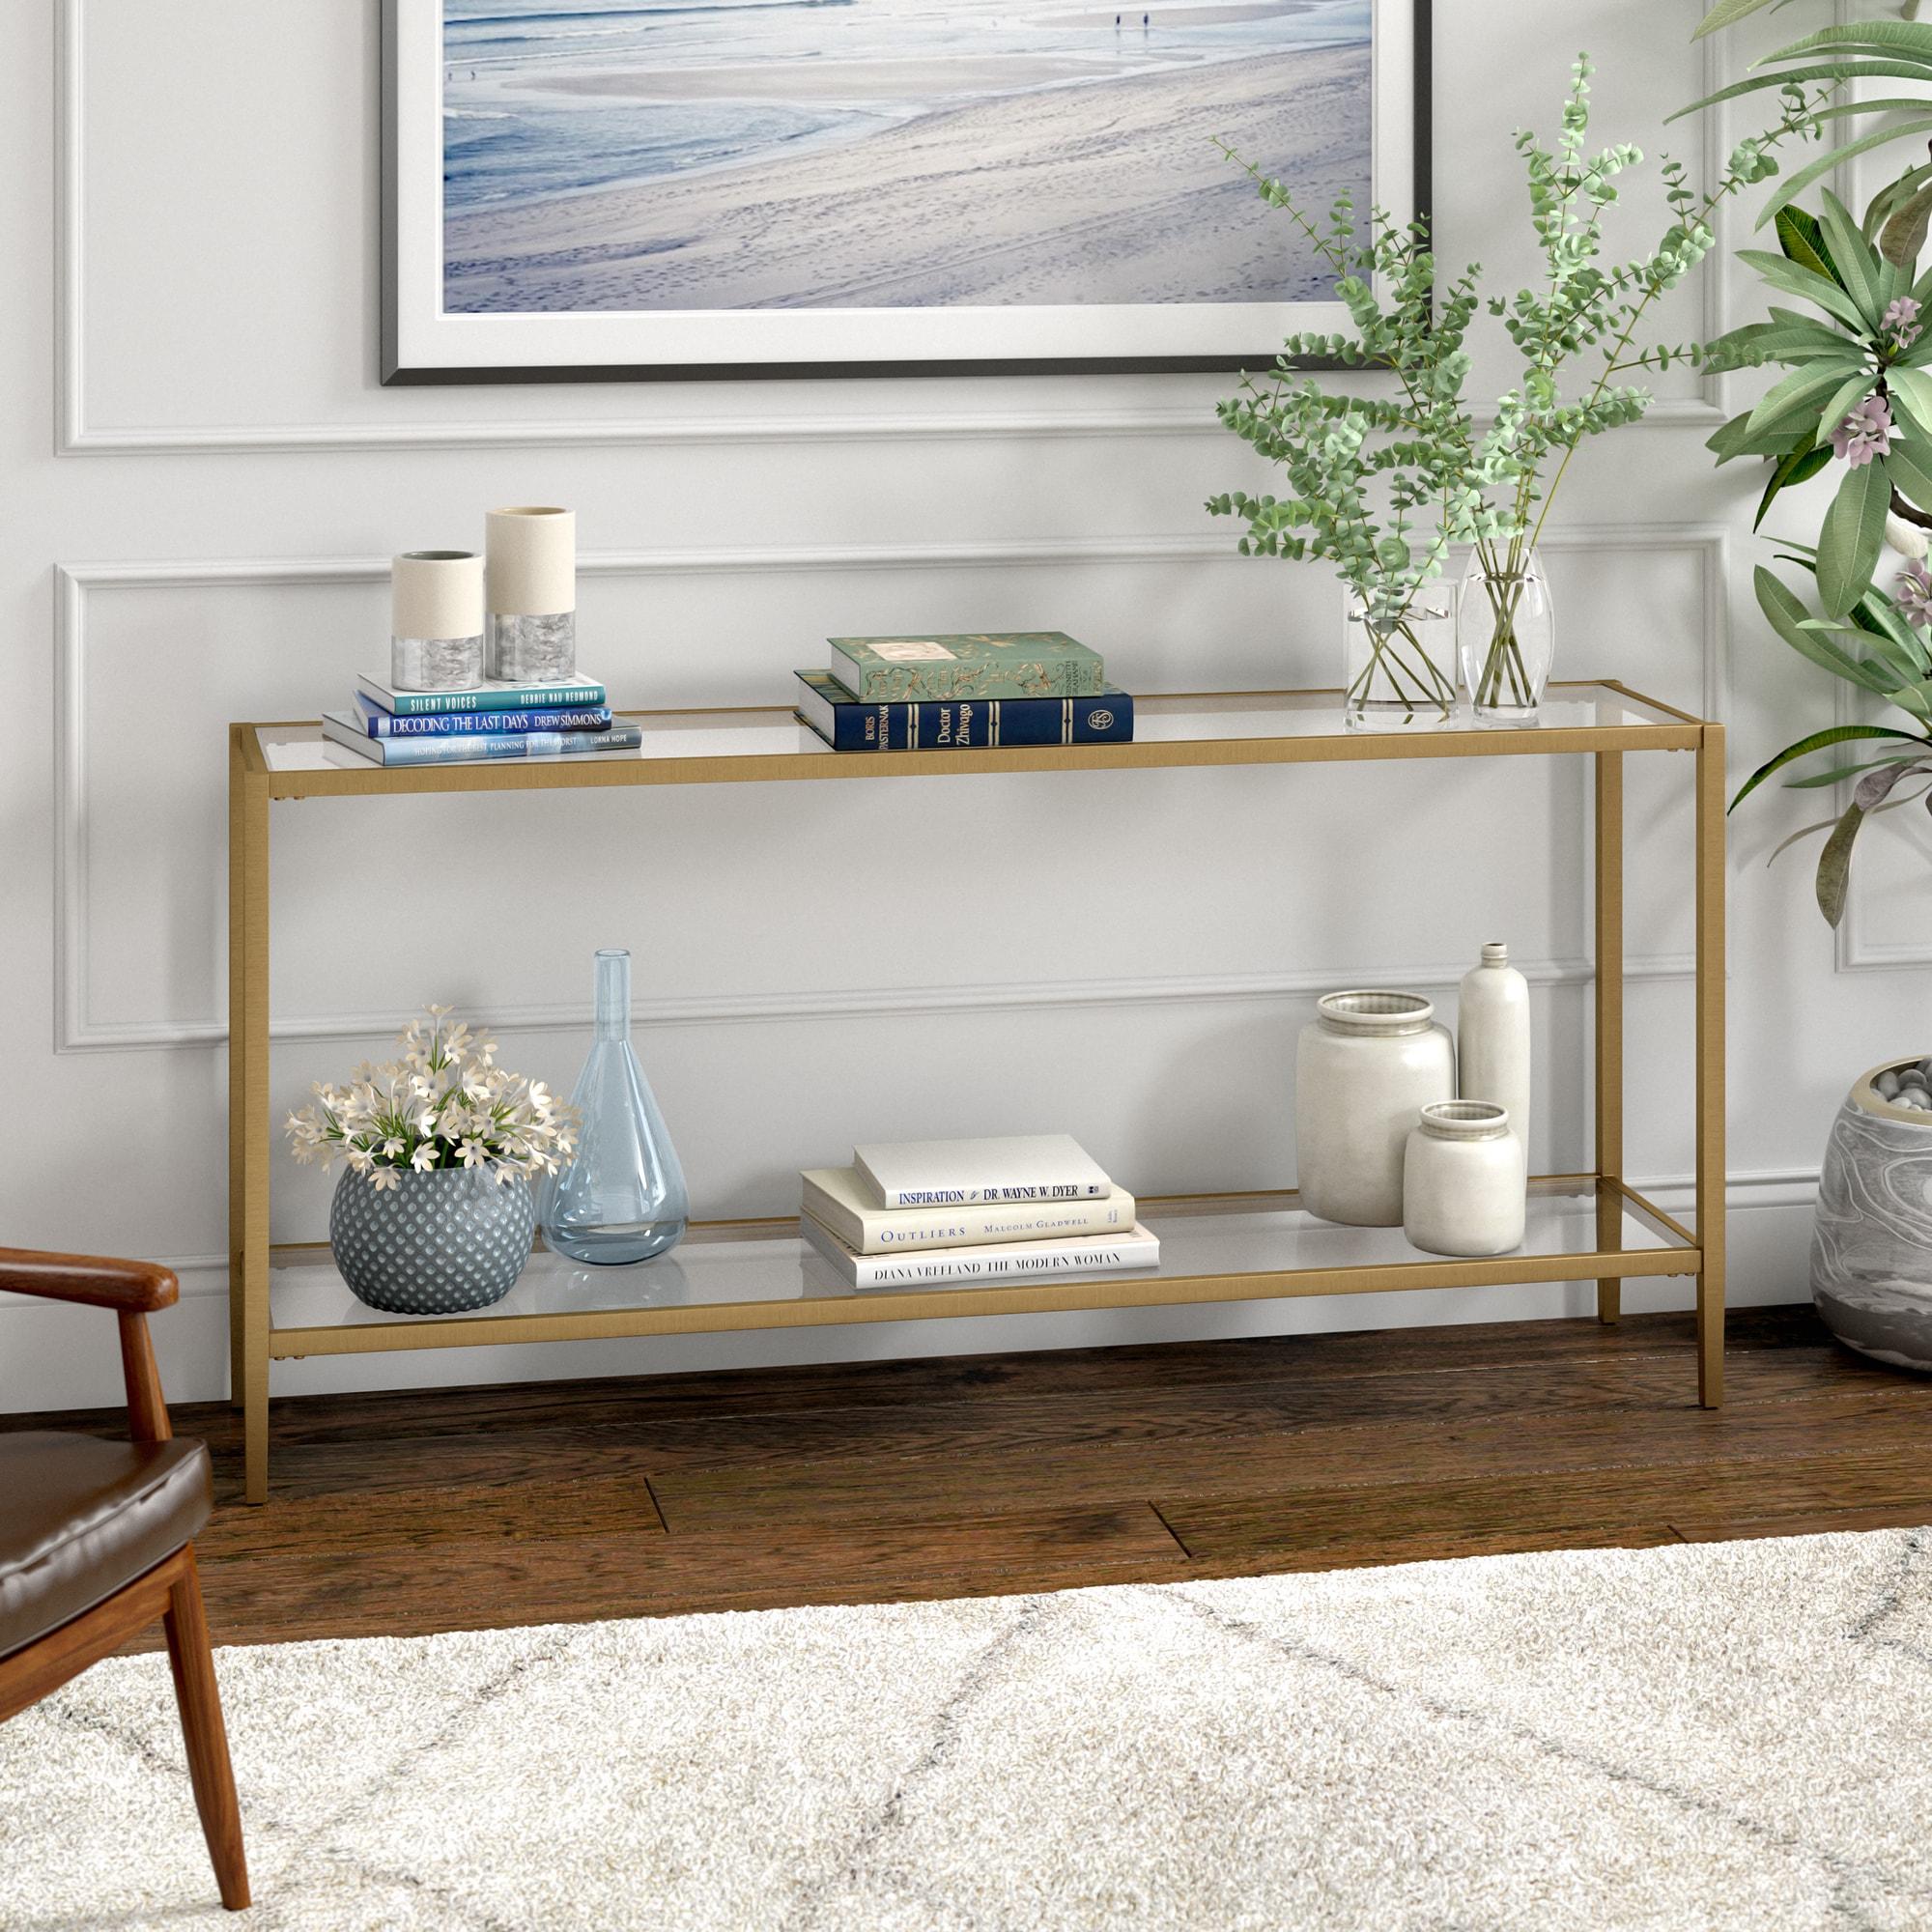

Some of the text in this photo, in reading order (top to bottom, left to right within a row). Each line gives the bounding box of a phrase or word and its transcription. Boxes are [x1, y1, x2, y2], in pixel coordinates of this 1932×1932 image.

[411, 696, 477, 712] SILENT VOICES
[520, 694, 546, 705] DEBBIE
[565, 690, 599, 702] REDMOND
[393, 714, 528, 733] DECODING THE LAST DAYS
[533, 713, 603, 726] DREW SIMMONS
[865, 716, 875, 741] BORIS
[879, 704, 890, 751] PASTERNAK
[937, 707, 952, 744] Doctor
[955, 703, 974, 746] Zhivago
[490, 739, 526, 752] PLANNING
[590, 733, 628, 745] LORNA HOPE
[898, 1189, 965, 1206] INSPIRATION
[982, 1187, 1001, 1201] DR.
[1002, 1185, 1037, 1200] WAYNE
[1038, 1185, 1051, 1198] W.
[1052, 1184, 1079, 1198] DYER
[874, 1252, 1121, 1280] DIANA VREELAND THE MODERN WOMAN
